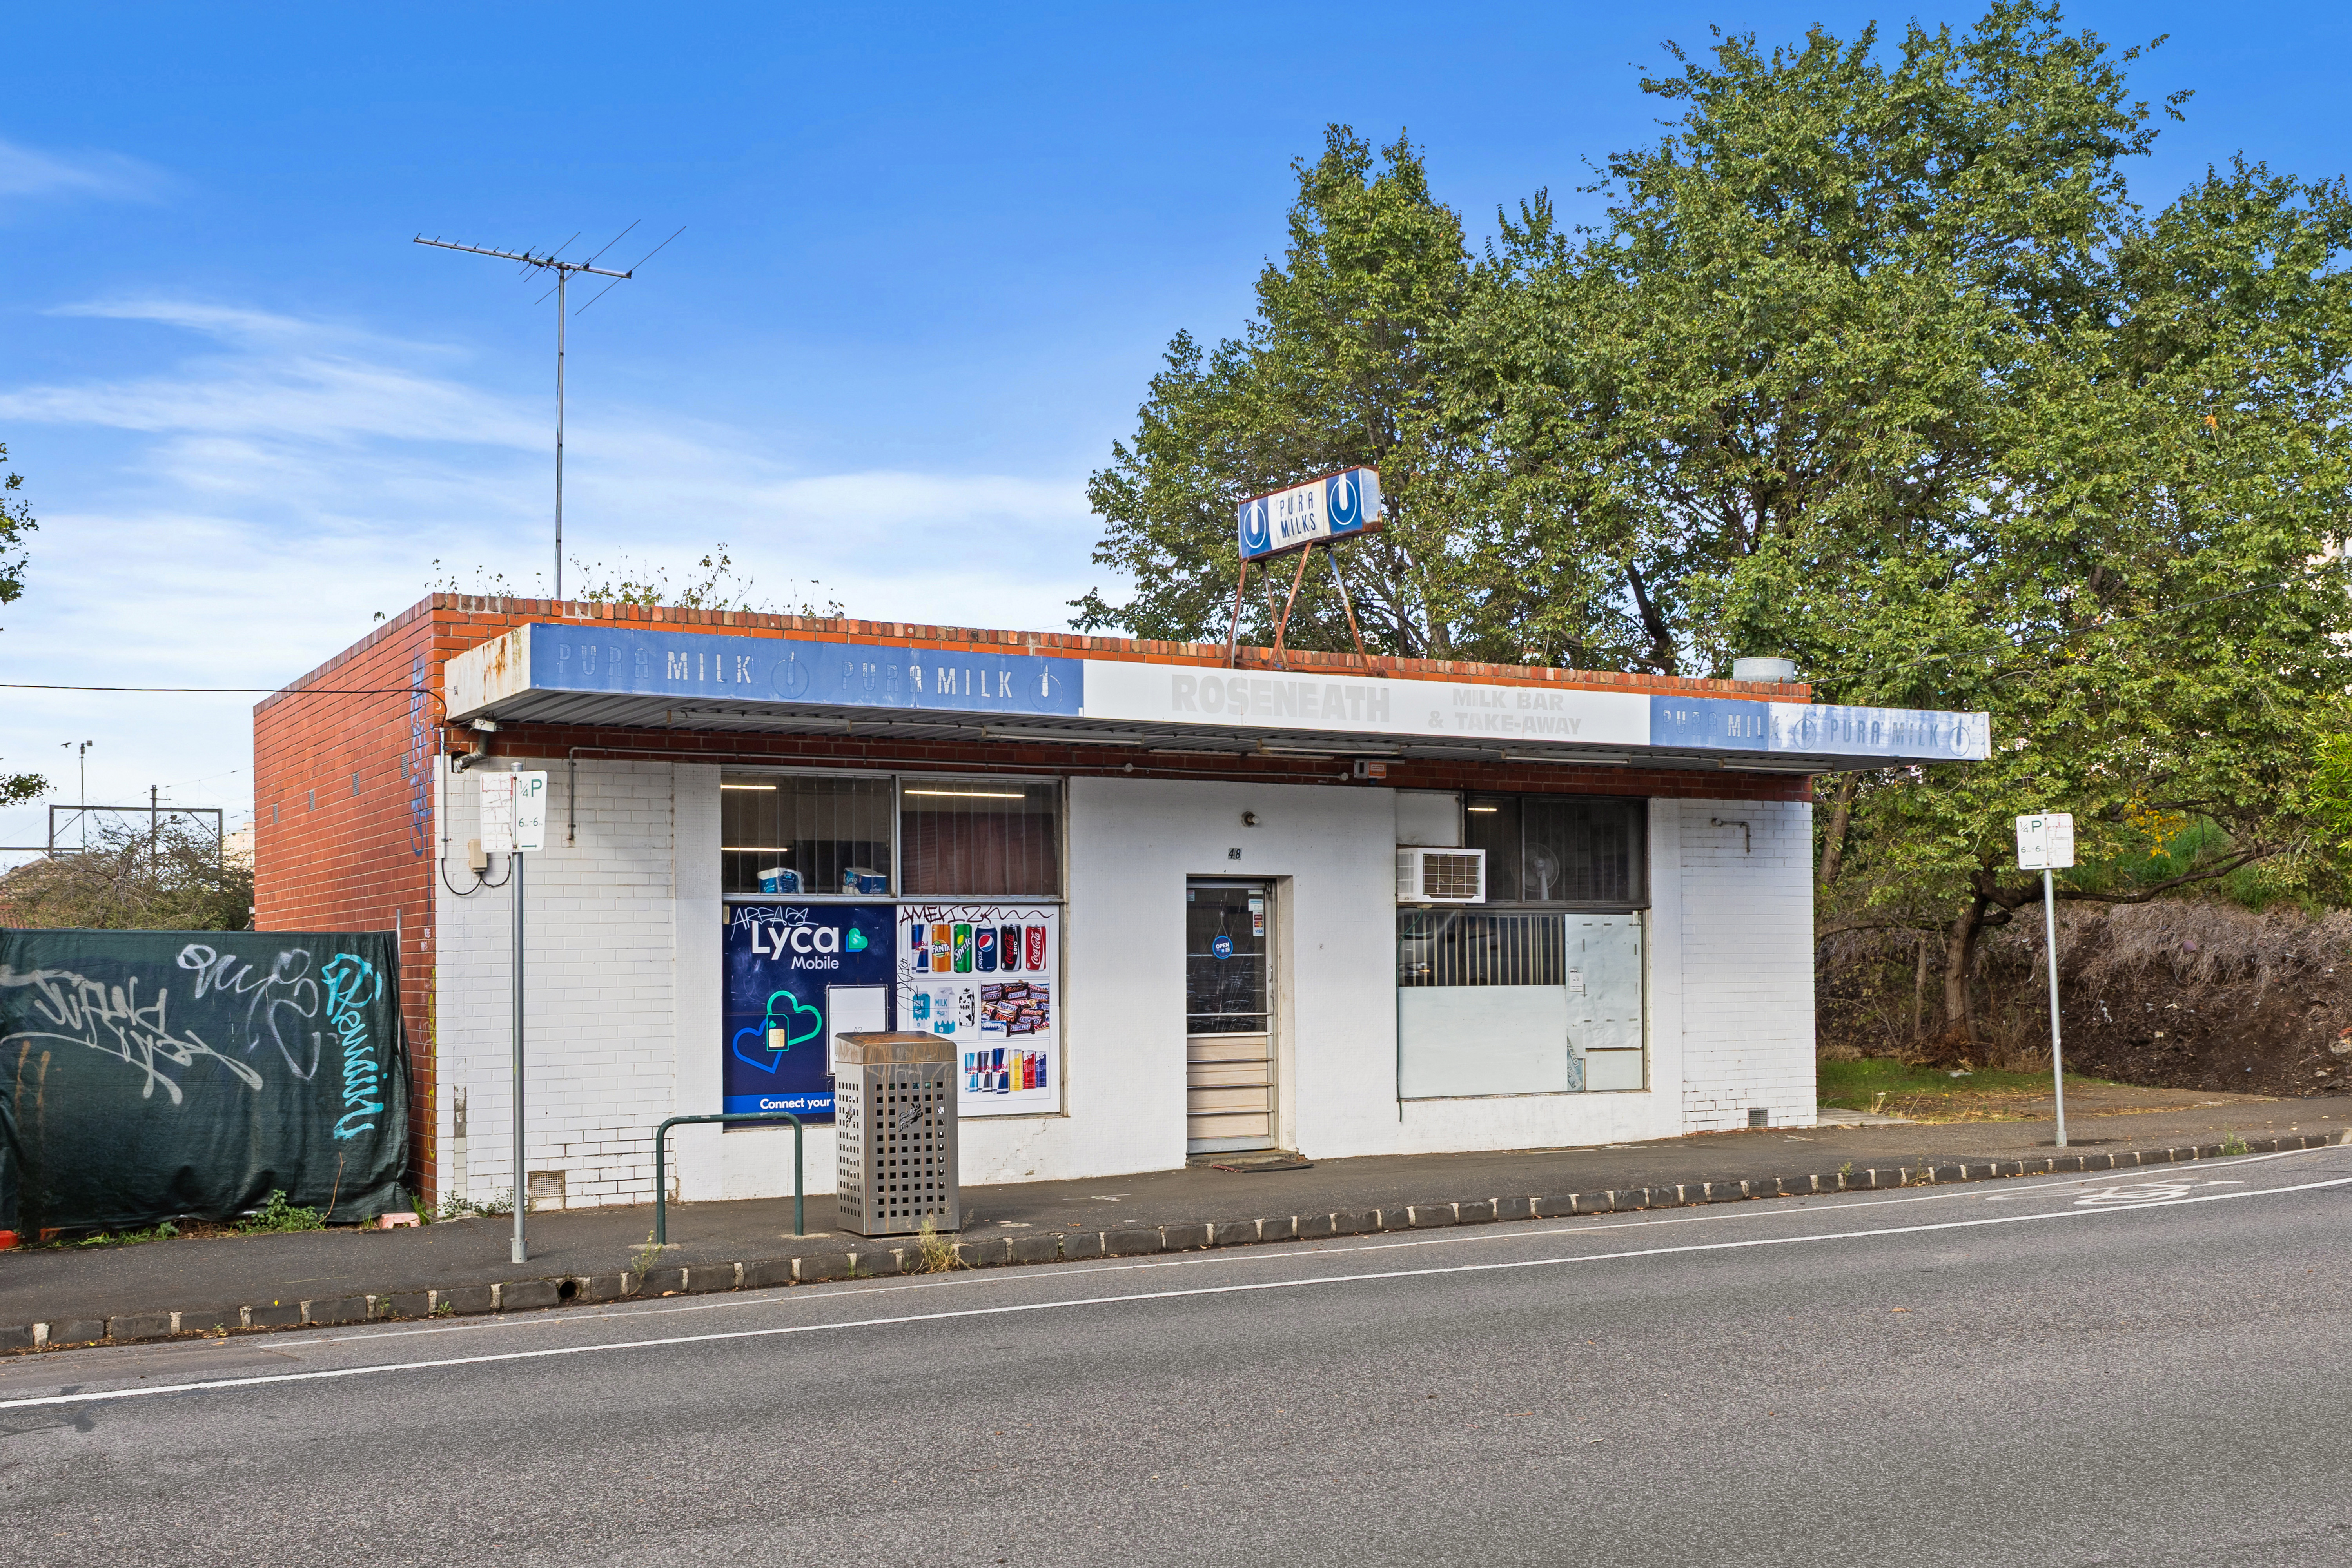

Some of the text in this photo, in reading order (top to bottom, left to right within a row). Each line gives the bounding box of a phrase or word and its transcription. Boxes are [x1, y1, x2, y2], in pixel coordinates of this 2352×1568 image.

[1280, 492, 1313, 517] PURA
[1281, 513, 1316, 538] MILKS
[559, 643, 751, 684] PURA MILK
[842, 661, 1013, 698] PURA MILK
[1172, 674, 1390, 722] ROSENEATH
[1453, 688, 1564, 711] MILK BAR
[1428, 711, 1582, 735] & TAKE-AWAY
[1663, 710, 1779, 738] PURA MILK
[1830, 718, 1938, 747] PURA MILK
[532, 779, 542, 797] P
[2032, 820, 2042, 832] P
[1229, 848, 1241, 859] 48
[752, 920, 839, 960] Lyca
[932, 943, 950, 953] FANTA
[954, 937, 972, 961] Sprite
[791, 956, 839, 970] Mobile
[760, 1098, 805, 1109] Connect
[807, 1098, 831, 1110] your
